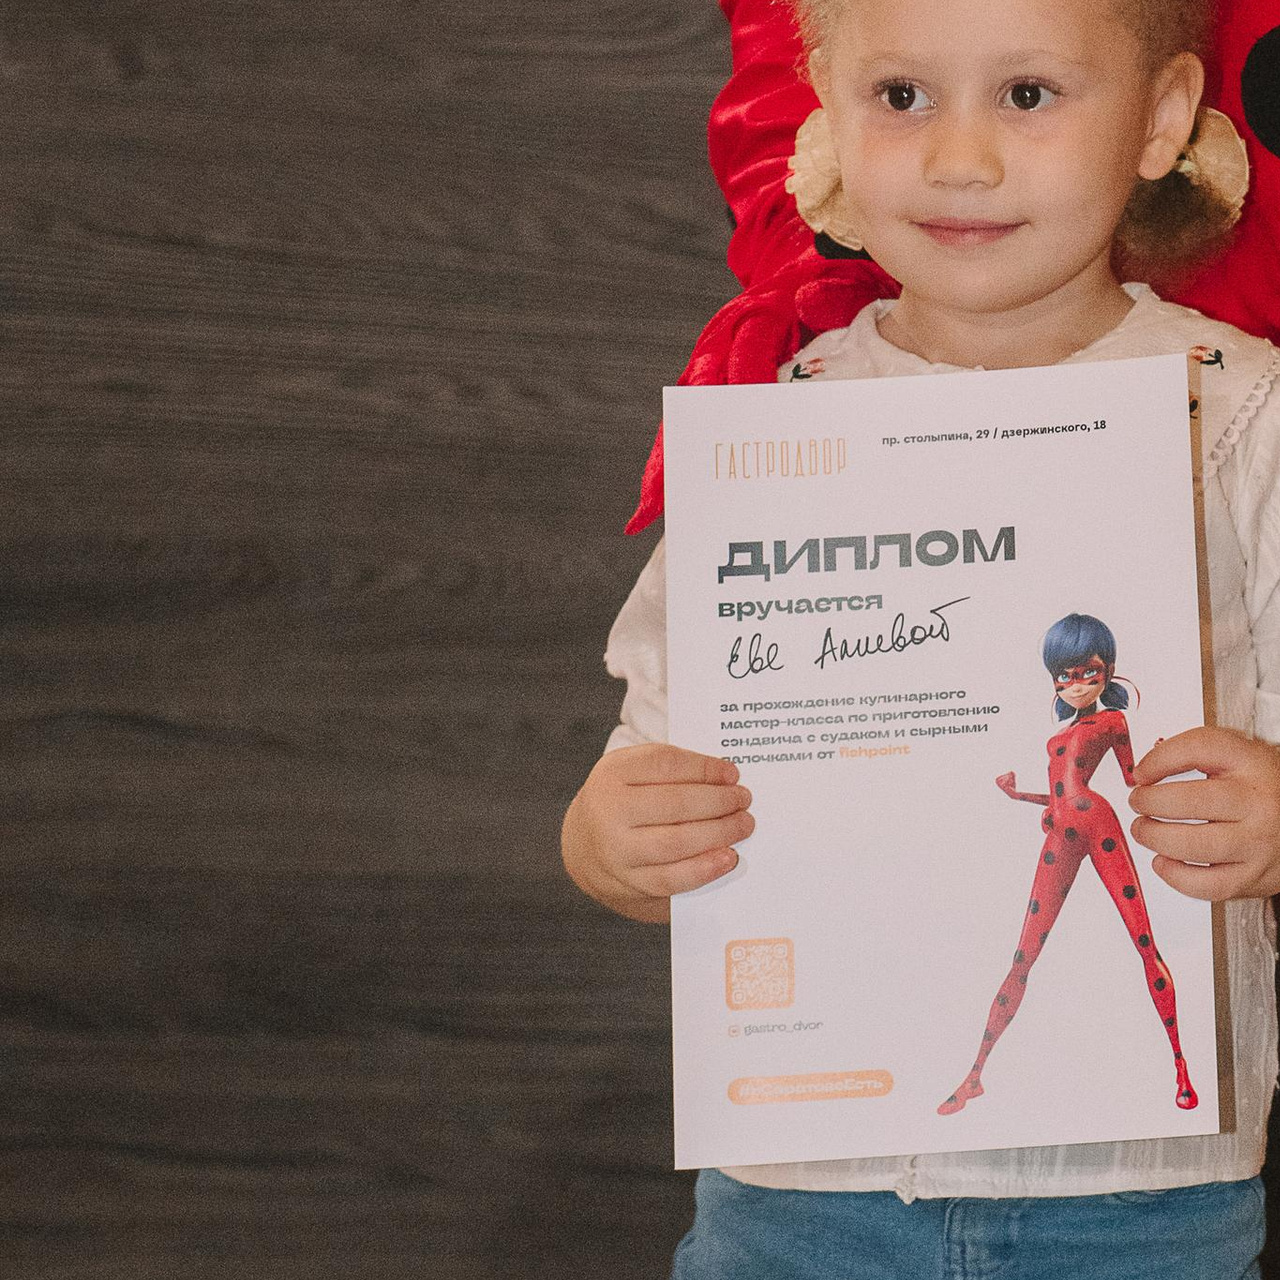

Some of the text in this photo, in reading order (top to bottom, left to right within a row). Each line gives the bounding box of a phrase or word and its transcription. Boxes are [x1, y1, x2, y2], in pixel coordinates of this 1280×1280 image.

[881, 436, 901, 447] пр.
[903, 430, 973, 445] столыпина,
[975, 428, 990, 439] 29
[1000, 421, 1091, 439] дзержинского,
[1093, 419, 1107, 430] 18
[714, 437, 847, 480] ГАСТРОДВОР
[717, 594, 884, 622] вручается
[719, 689, 967, 713] за прохождение кулинарного
[720, 704, 1001, 731] мастер-класса по приготовлению
[720, 722, 990, 749] сэндвича с судаком и сырными
[817, 748, 836, 760] от
[839, 743, 911, 760] fishpoint
[744, 1020, 825, 1037] gastro_dvor
